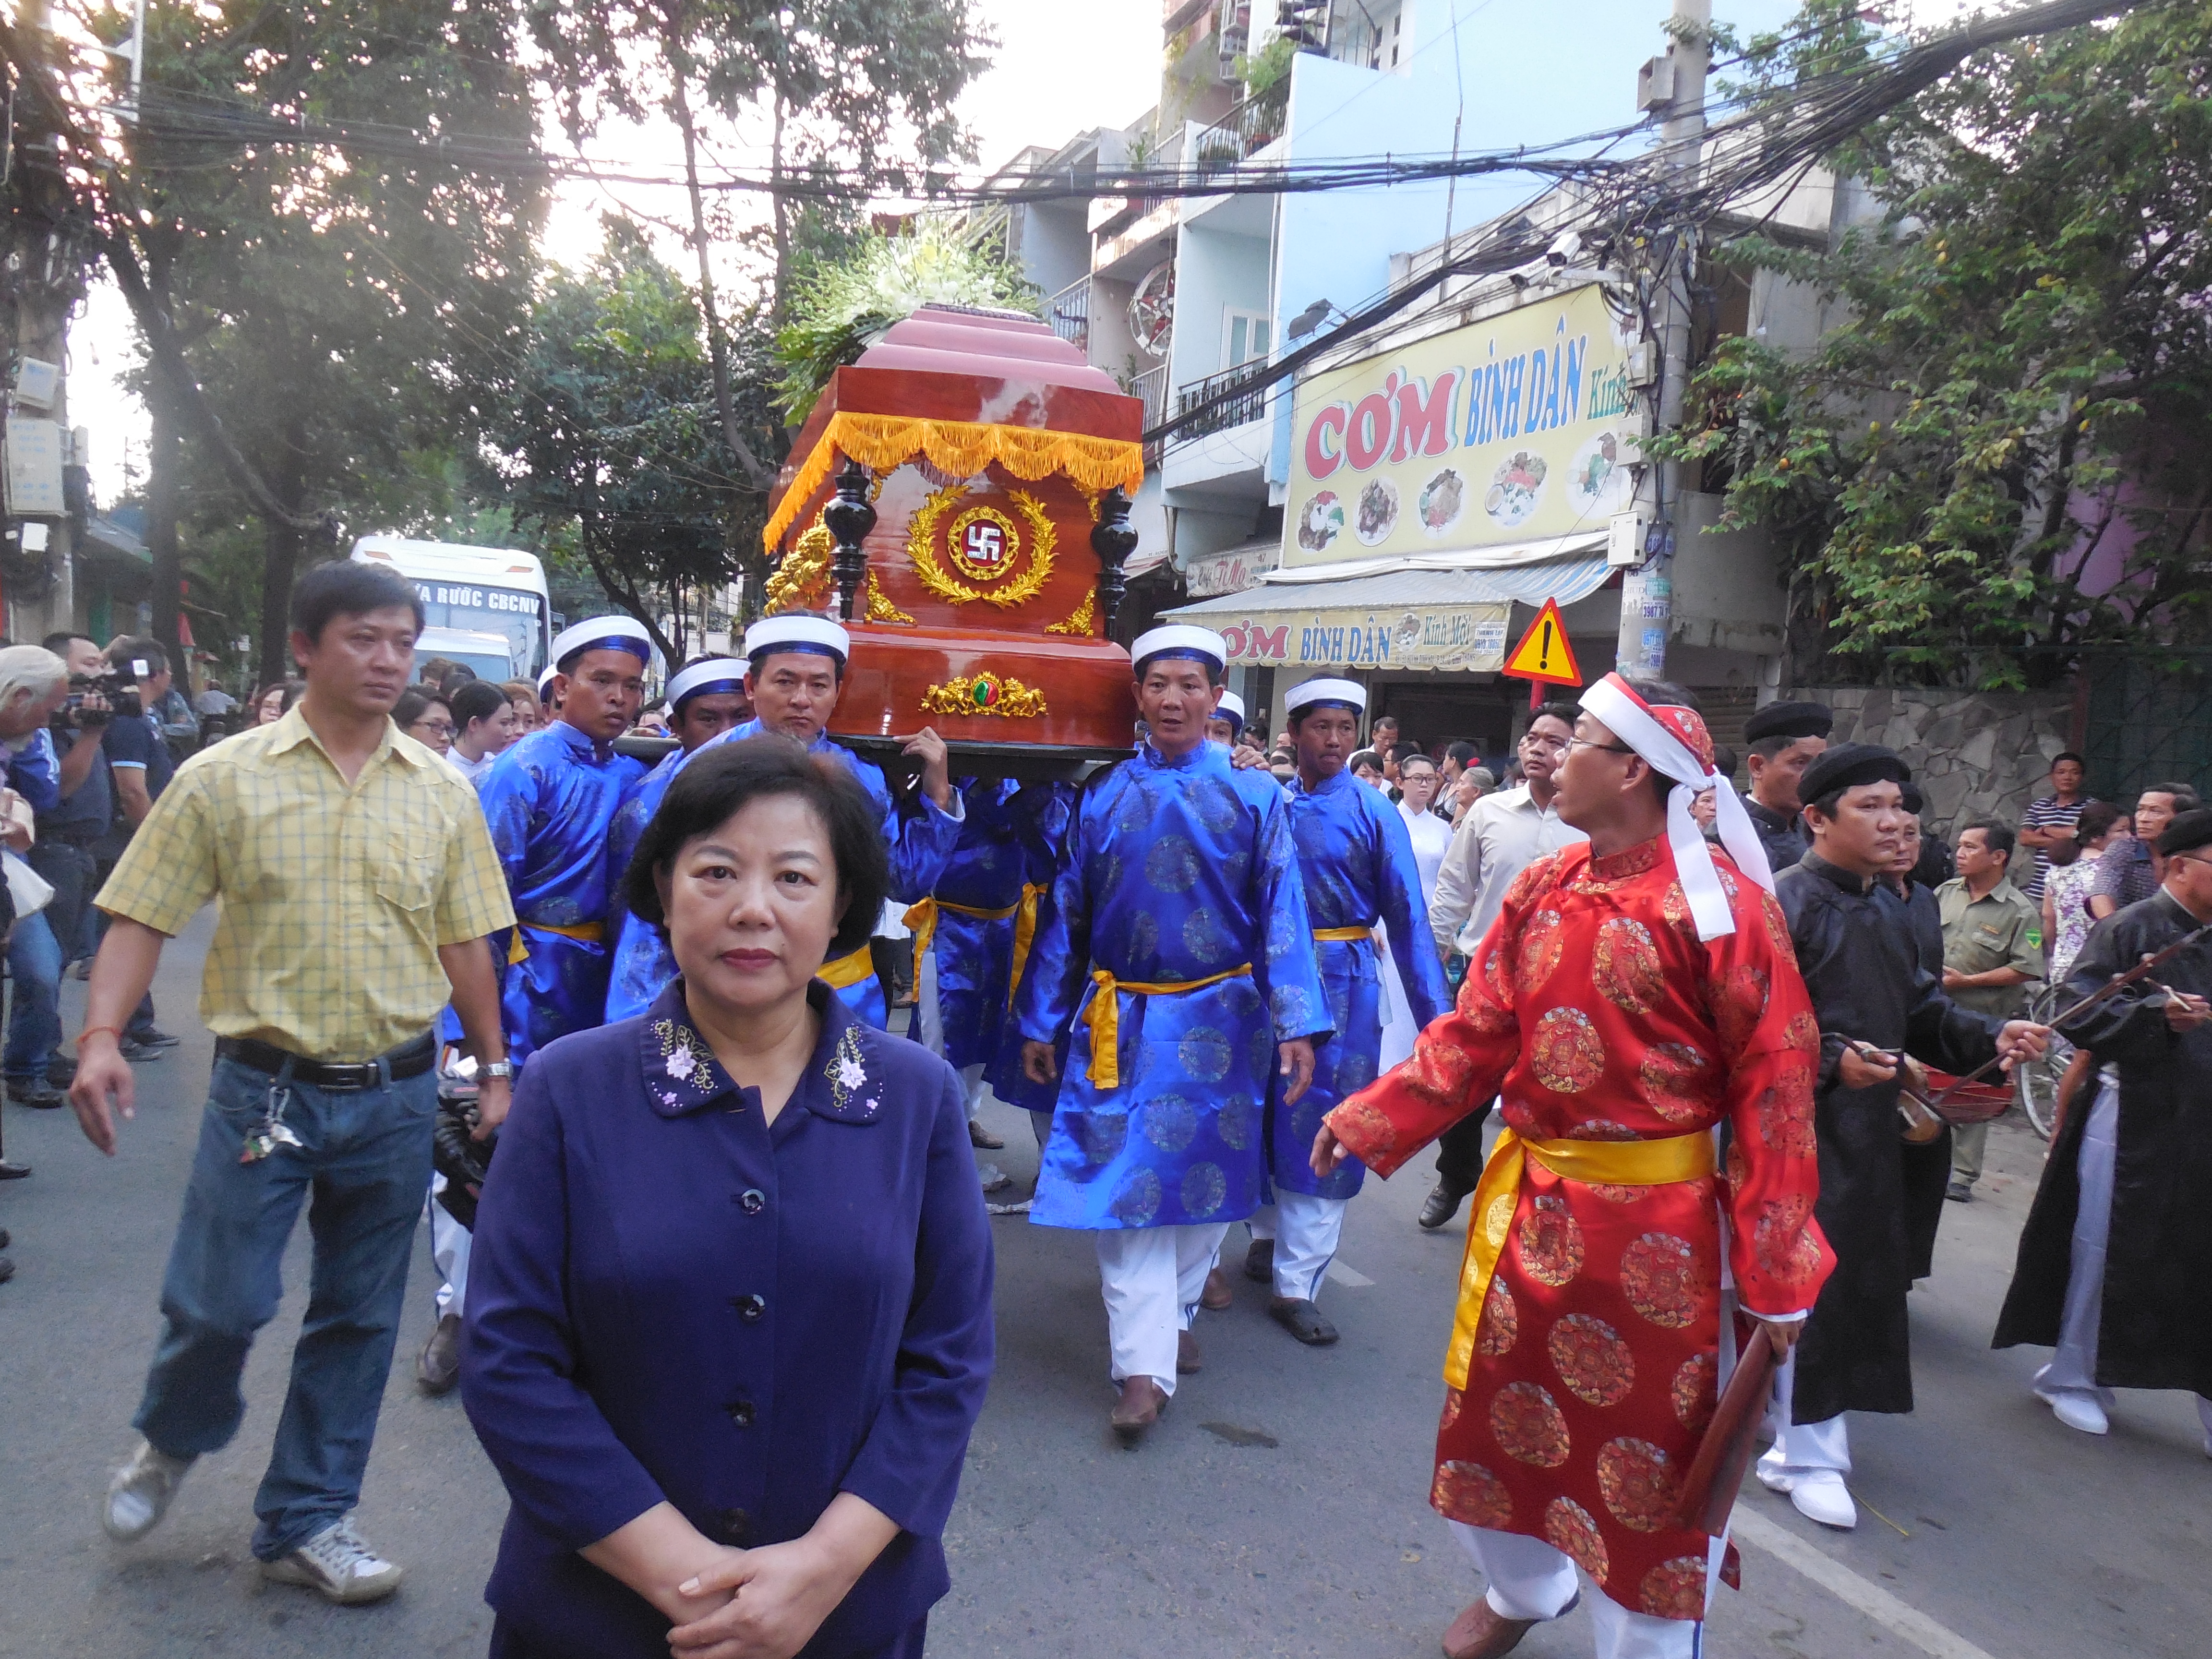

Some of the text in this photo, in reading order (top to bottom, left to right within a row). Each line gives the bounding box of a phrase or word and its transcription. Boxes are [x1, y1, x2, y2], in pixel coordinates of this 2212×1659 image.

[1304, 366, 1462, 481] CƠM
[1464, 338, 1526, 447] BÌNH
[1524, 313, 1587, 434] DÂN
[488, 592, 540, 614] CBCNV
[1217, 618, 1291, 660] ƠM
[1299, 616, 1345, 661] BÌNH
[1347, 614, 1392, 662] DÂN
